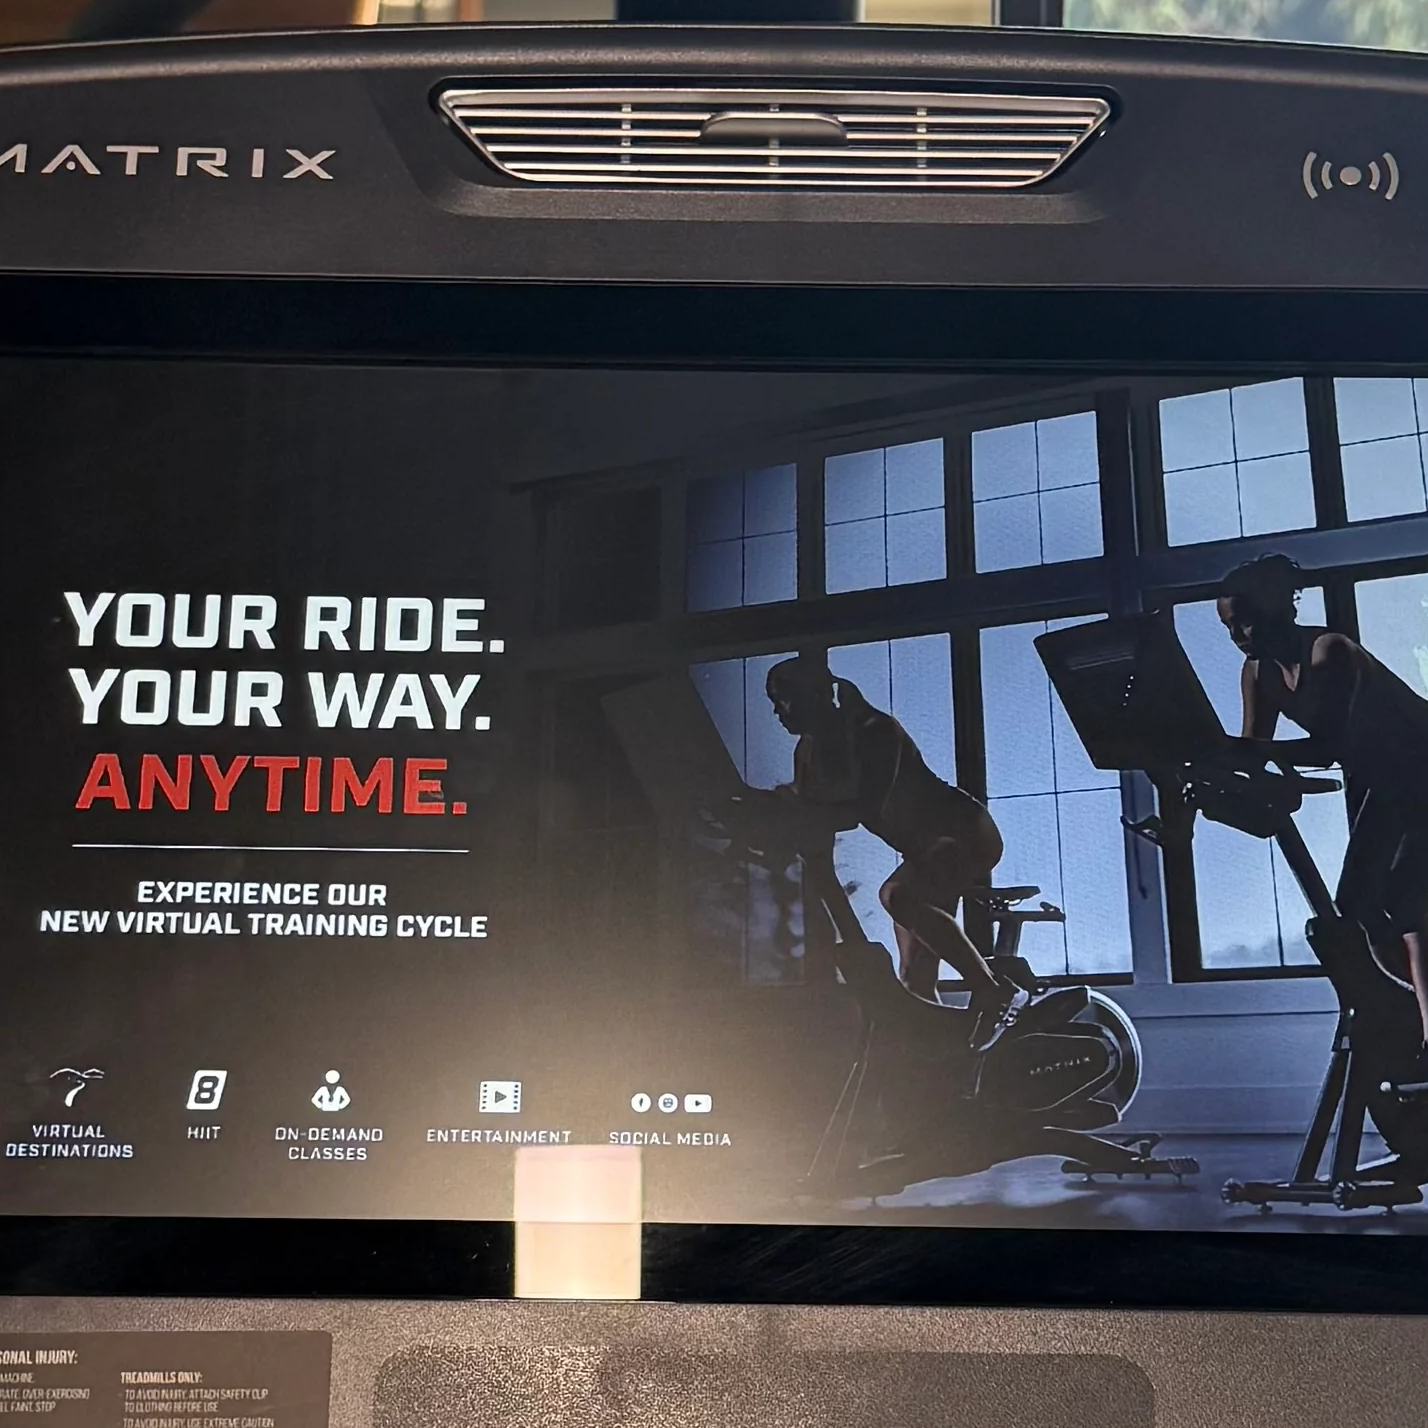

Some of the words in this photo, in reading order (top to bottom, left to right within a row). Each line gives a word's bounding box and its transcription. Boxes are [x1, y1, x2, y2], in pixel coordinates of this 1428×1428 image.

[64, 592, 277, 650] YOUR
[303, 595, 504, 652] RIDE.
[68, 668, 283, 727] YOUR
[307, 672, 491, 730] WAY.
[75, 753, 467, 814] ANYTIME.
[137, 881, 320, 905] EXPERIENCE
[327, 883, 387, 906] OUR
[40, 910, 110, 933] NEW
[117, 911, 241, 935] VIRTUAL
[248, 913, 388, 936] TRAINING
[397, 915, 488, 938] CYCLE
[32, 1124, 106, 1139] VIRTUAL
[187, 1126, 221, 1140] HIIT
[275, 1126, 383, 1142] ON-DEMAND
[426, 1129, 572, 1144] ENTERTAINMENT
[609, 1131, 672, 1146] SOCIAL
[677, 1133, 732, 1146] MEDIA
[5, 1143, 134, 1159] DESTINATIONS
[288, 1146, 368, 1161] CLASSES
[36, 1350, 79, 1365] INJURY:
[121, 1371, 176, 1384] TREADMILLS
[125, 1389, 135, 1401] TO
[221, 1388, 250, 1400] SAFETY
